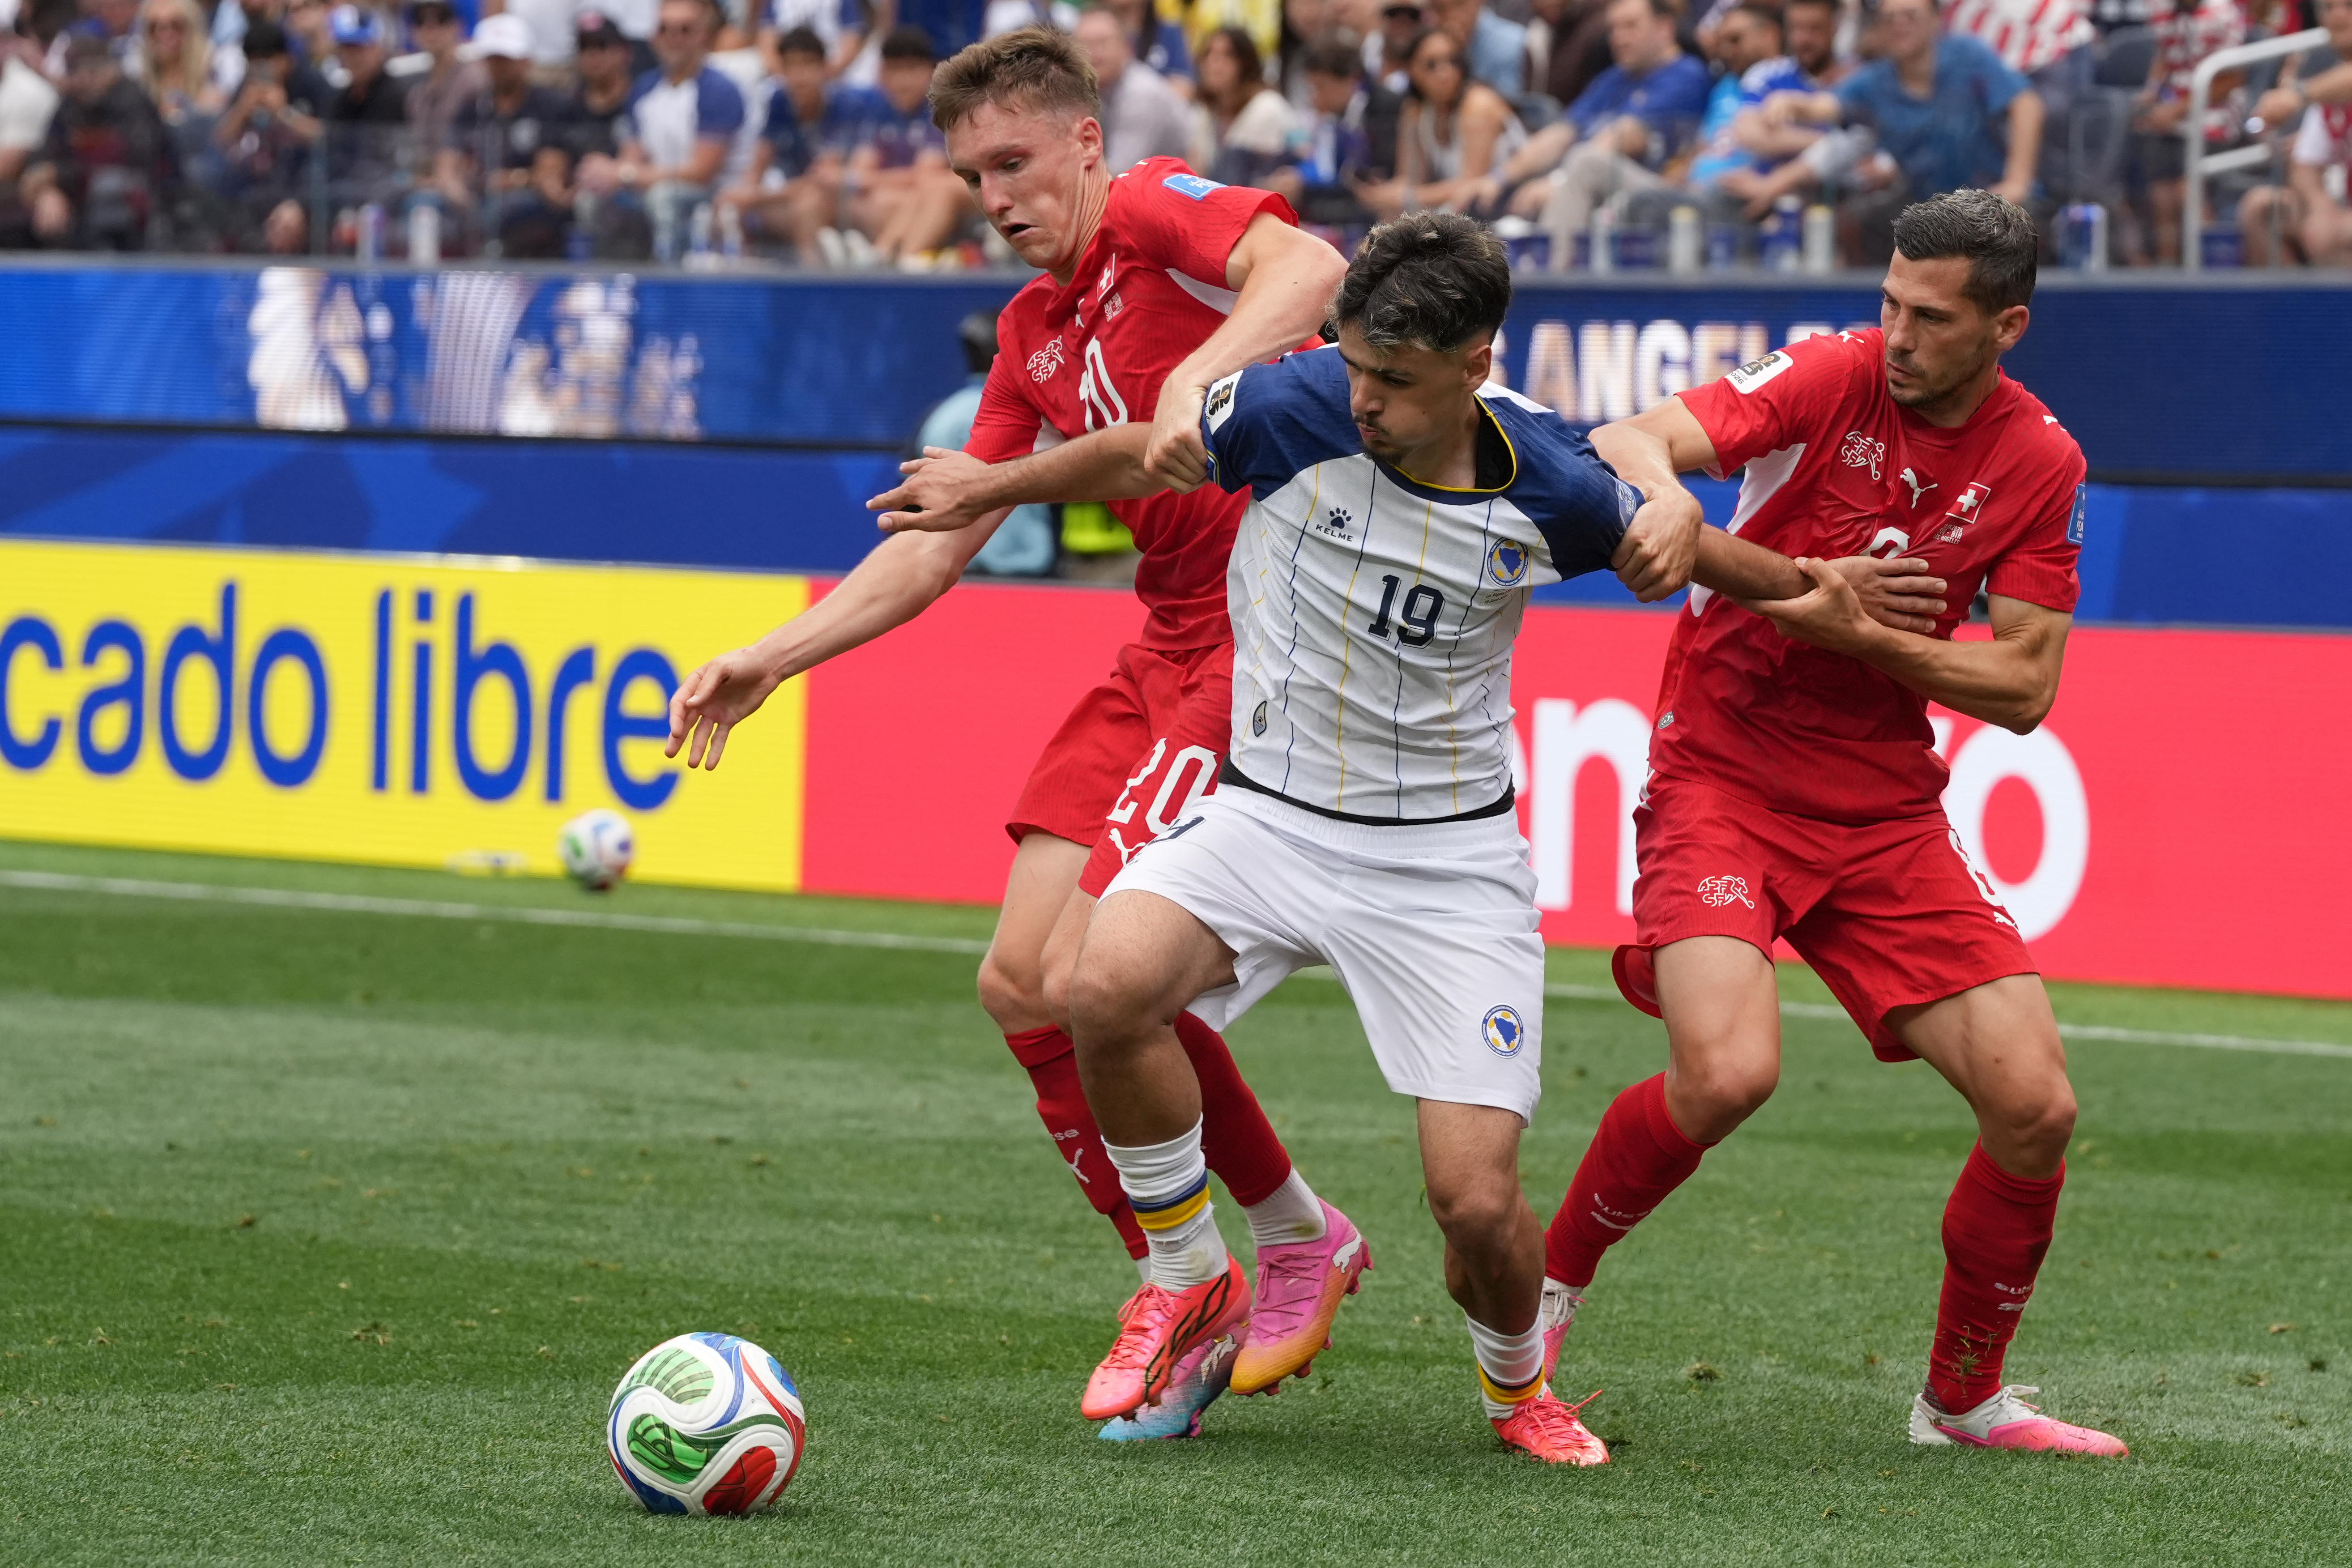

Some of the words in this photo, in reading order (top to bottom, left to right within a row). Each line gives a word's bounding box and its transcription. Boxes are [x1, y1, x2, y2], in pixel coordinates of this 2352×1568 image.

[1526, 320, 1881, 424] ANGE
[1316, 524, 1354, 542] KELME
[1940, 535, 1960, 545] ANGELES
[1951, 530, 1963, 540] BIH
[1368, 575, 1446, 649] 19
[0, 580, 328, 787] cado
[372, 587, 682, 810] libre
[1106, 737, 1217, 835] 20
